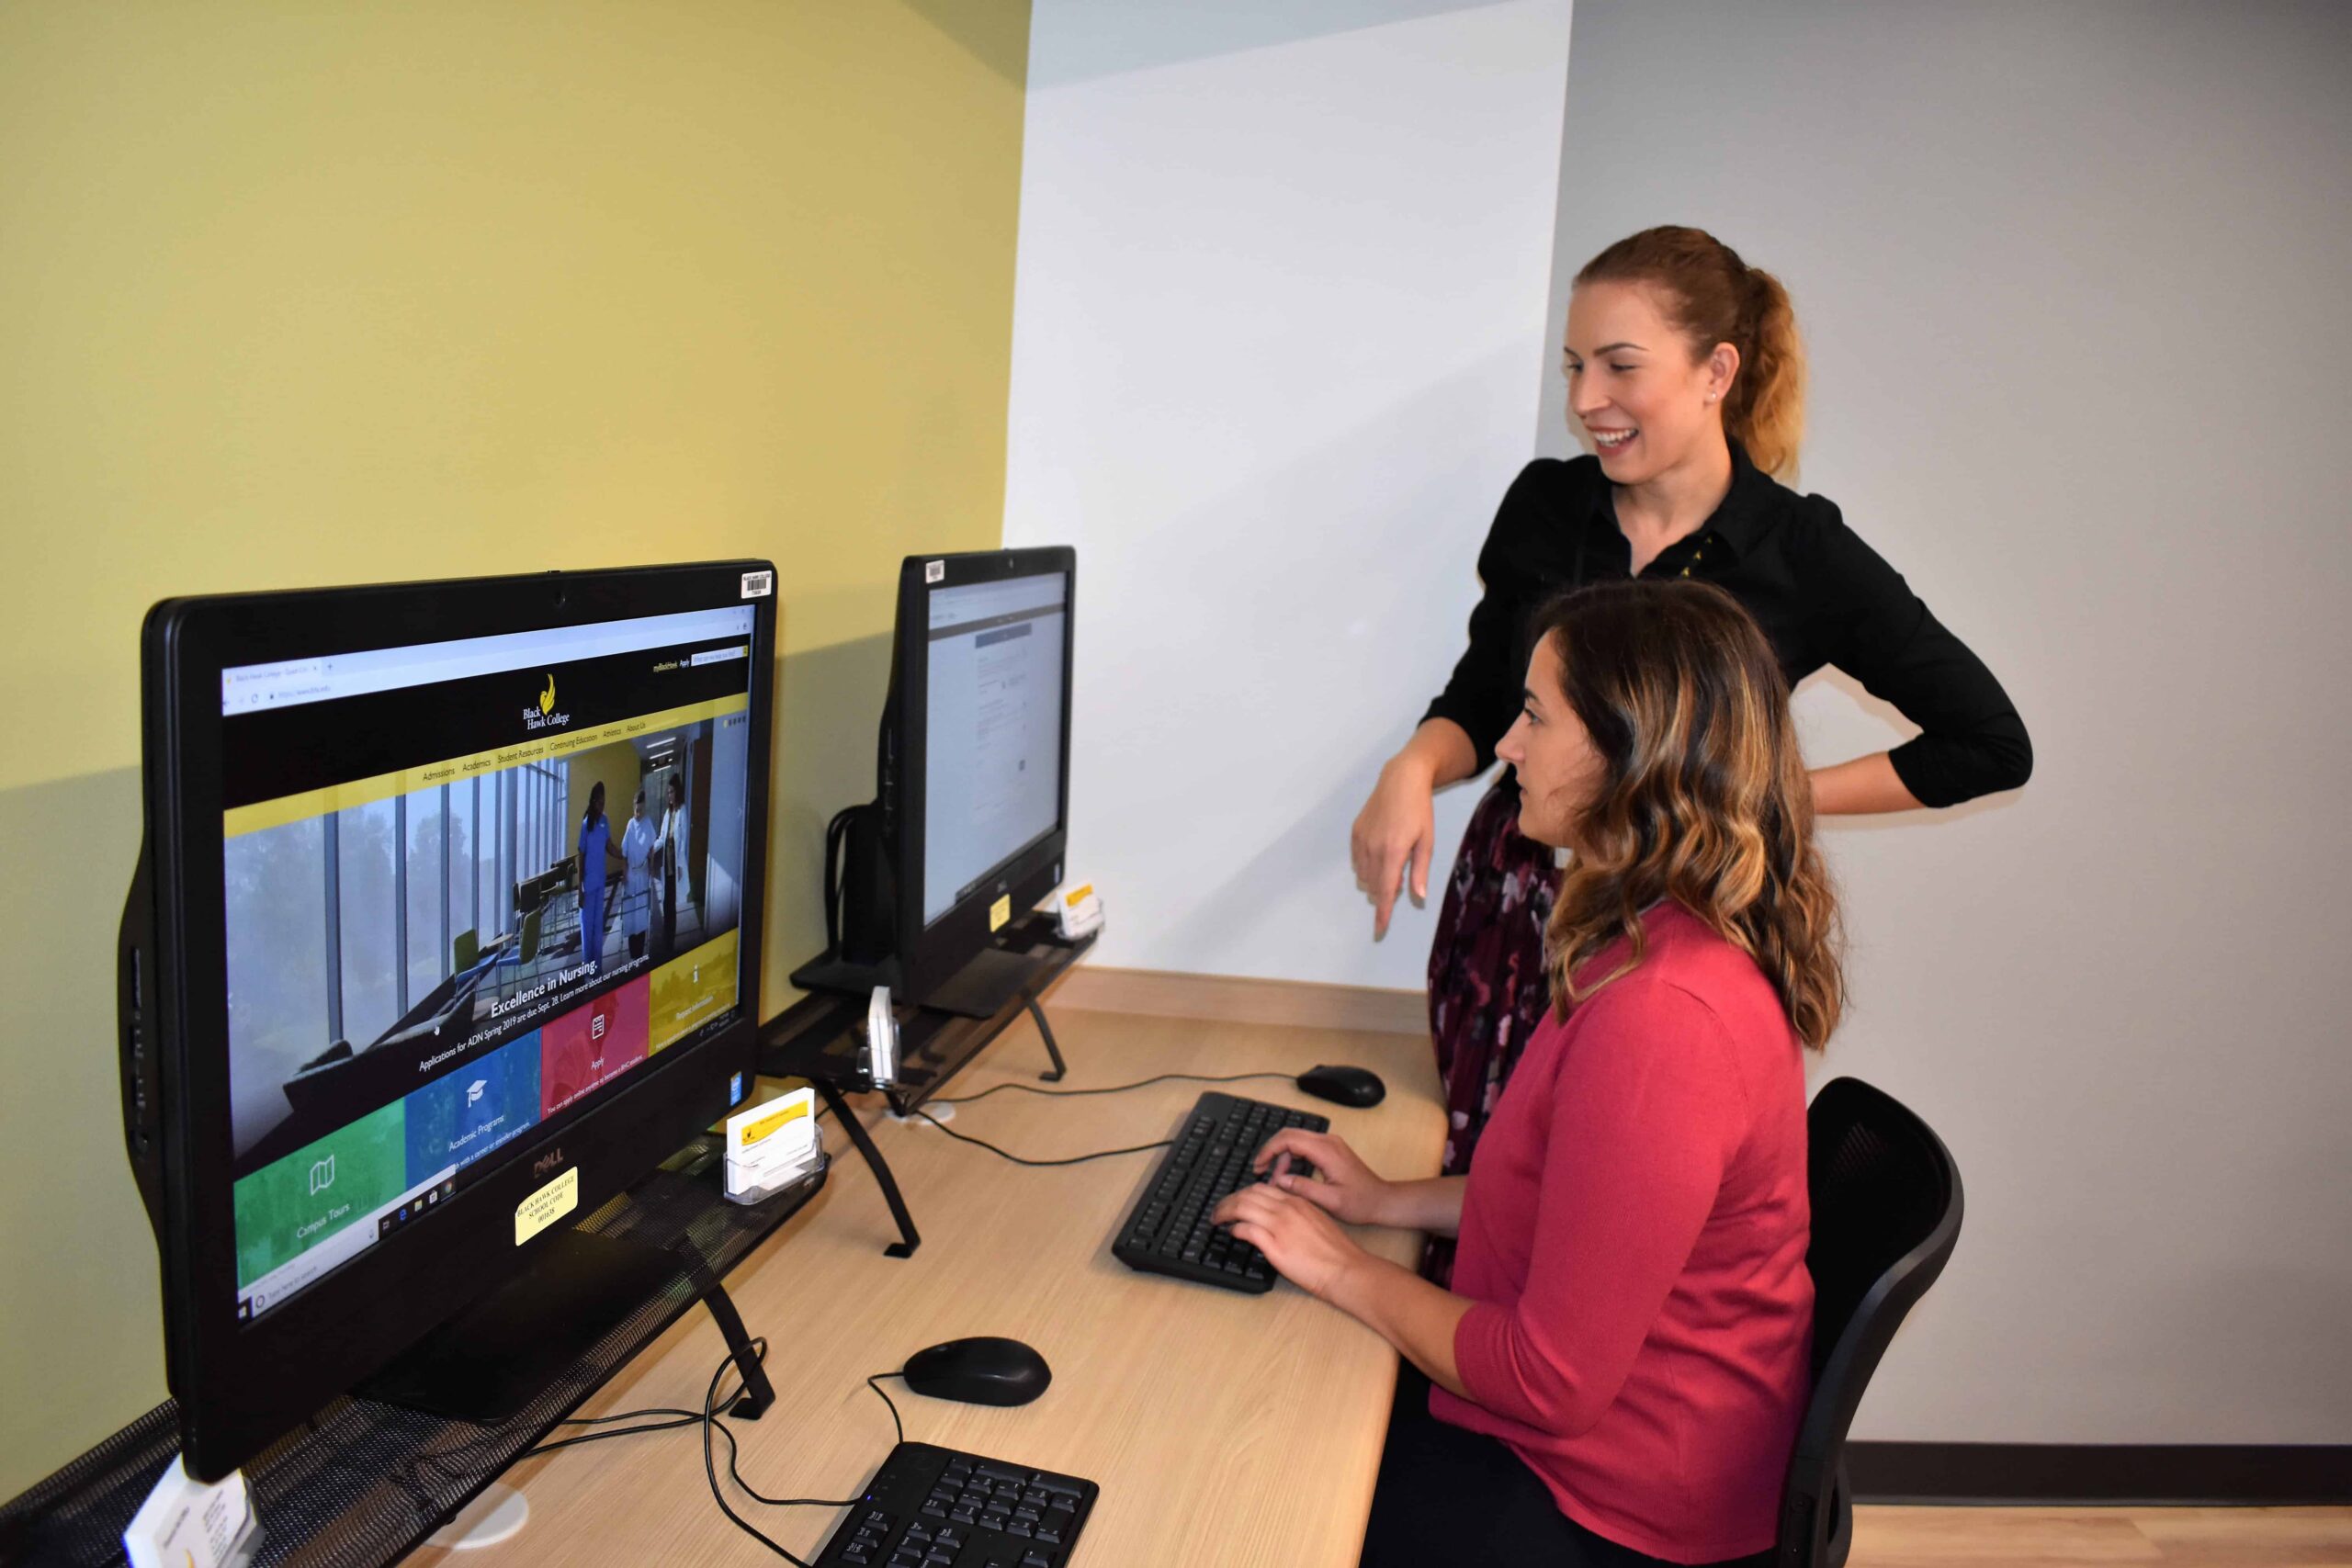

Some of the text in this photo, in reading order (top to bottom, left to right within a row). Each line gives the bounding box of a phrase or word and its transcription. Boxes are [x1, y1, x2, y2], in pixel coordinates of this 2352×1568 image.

[523, 705, 541, 720] Black
[527, 712, 570, 730] Hawk College
[423, 721, 646, 781] Admissions Academics Student Resources Continuing Education Athletics About Us
[491, 960, 598, 1019] Excellence in Nursing.
[419, 1047, 457, 1072] Applications
[457, 1042, 467, 1053] for
[467, 1032, 483, 1048] ADN
[484, 1023, 503, 1041] Spring
[503, 1015, 516, 1031] 2019
[516, 1012, 526, 1023] are
[526, 1007, 537, 1019] due
[537, 1001, 551, 1014] Sept.
[560, 990, 574, 1002] Learn
[575, 984, 588, 995] more
[589, 976, 603, 988] about
[602, 971, 612, 981] our
[611, 963, 628, 976] nursing
[591, 1055, 605, 1071] Apply
[562, 1096, 573, 1107] apply
[448, 1115, 504, 1152] Academic Programs
[534, 1146, 564, 1179] DELL
[517, 1175, 575, 1217] BLACK HAWK COLLEGE
[528, 1190, 564, 1220] SCHOOL CODE
[296, 1203, 350, 1238] Campus Tours
